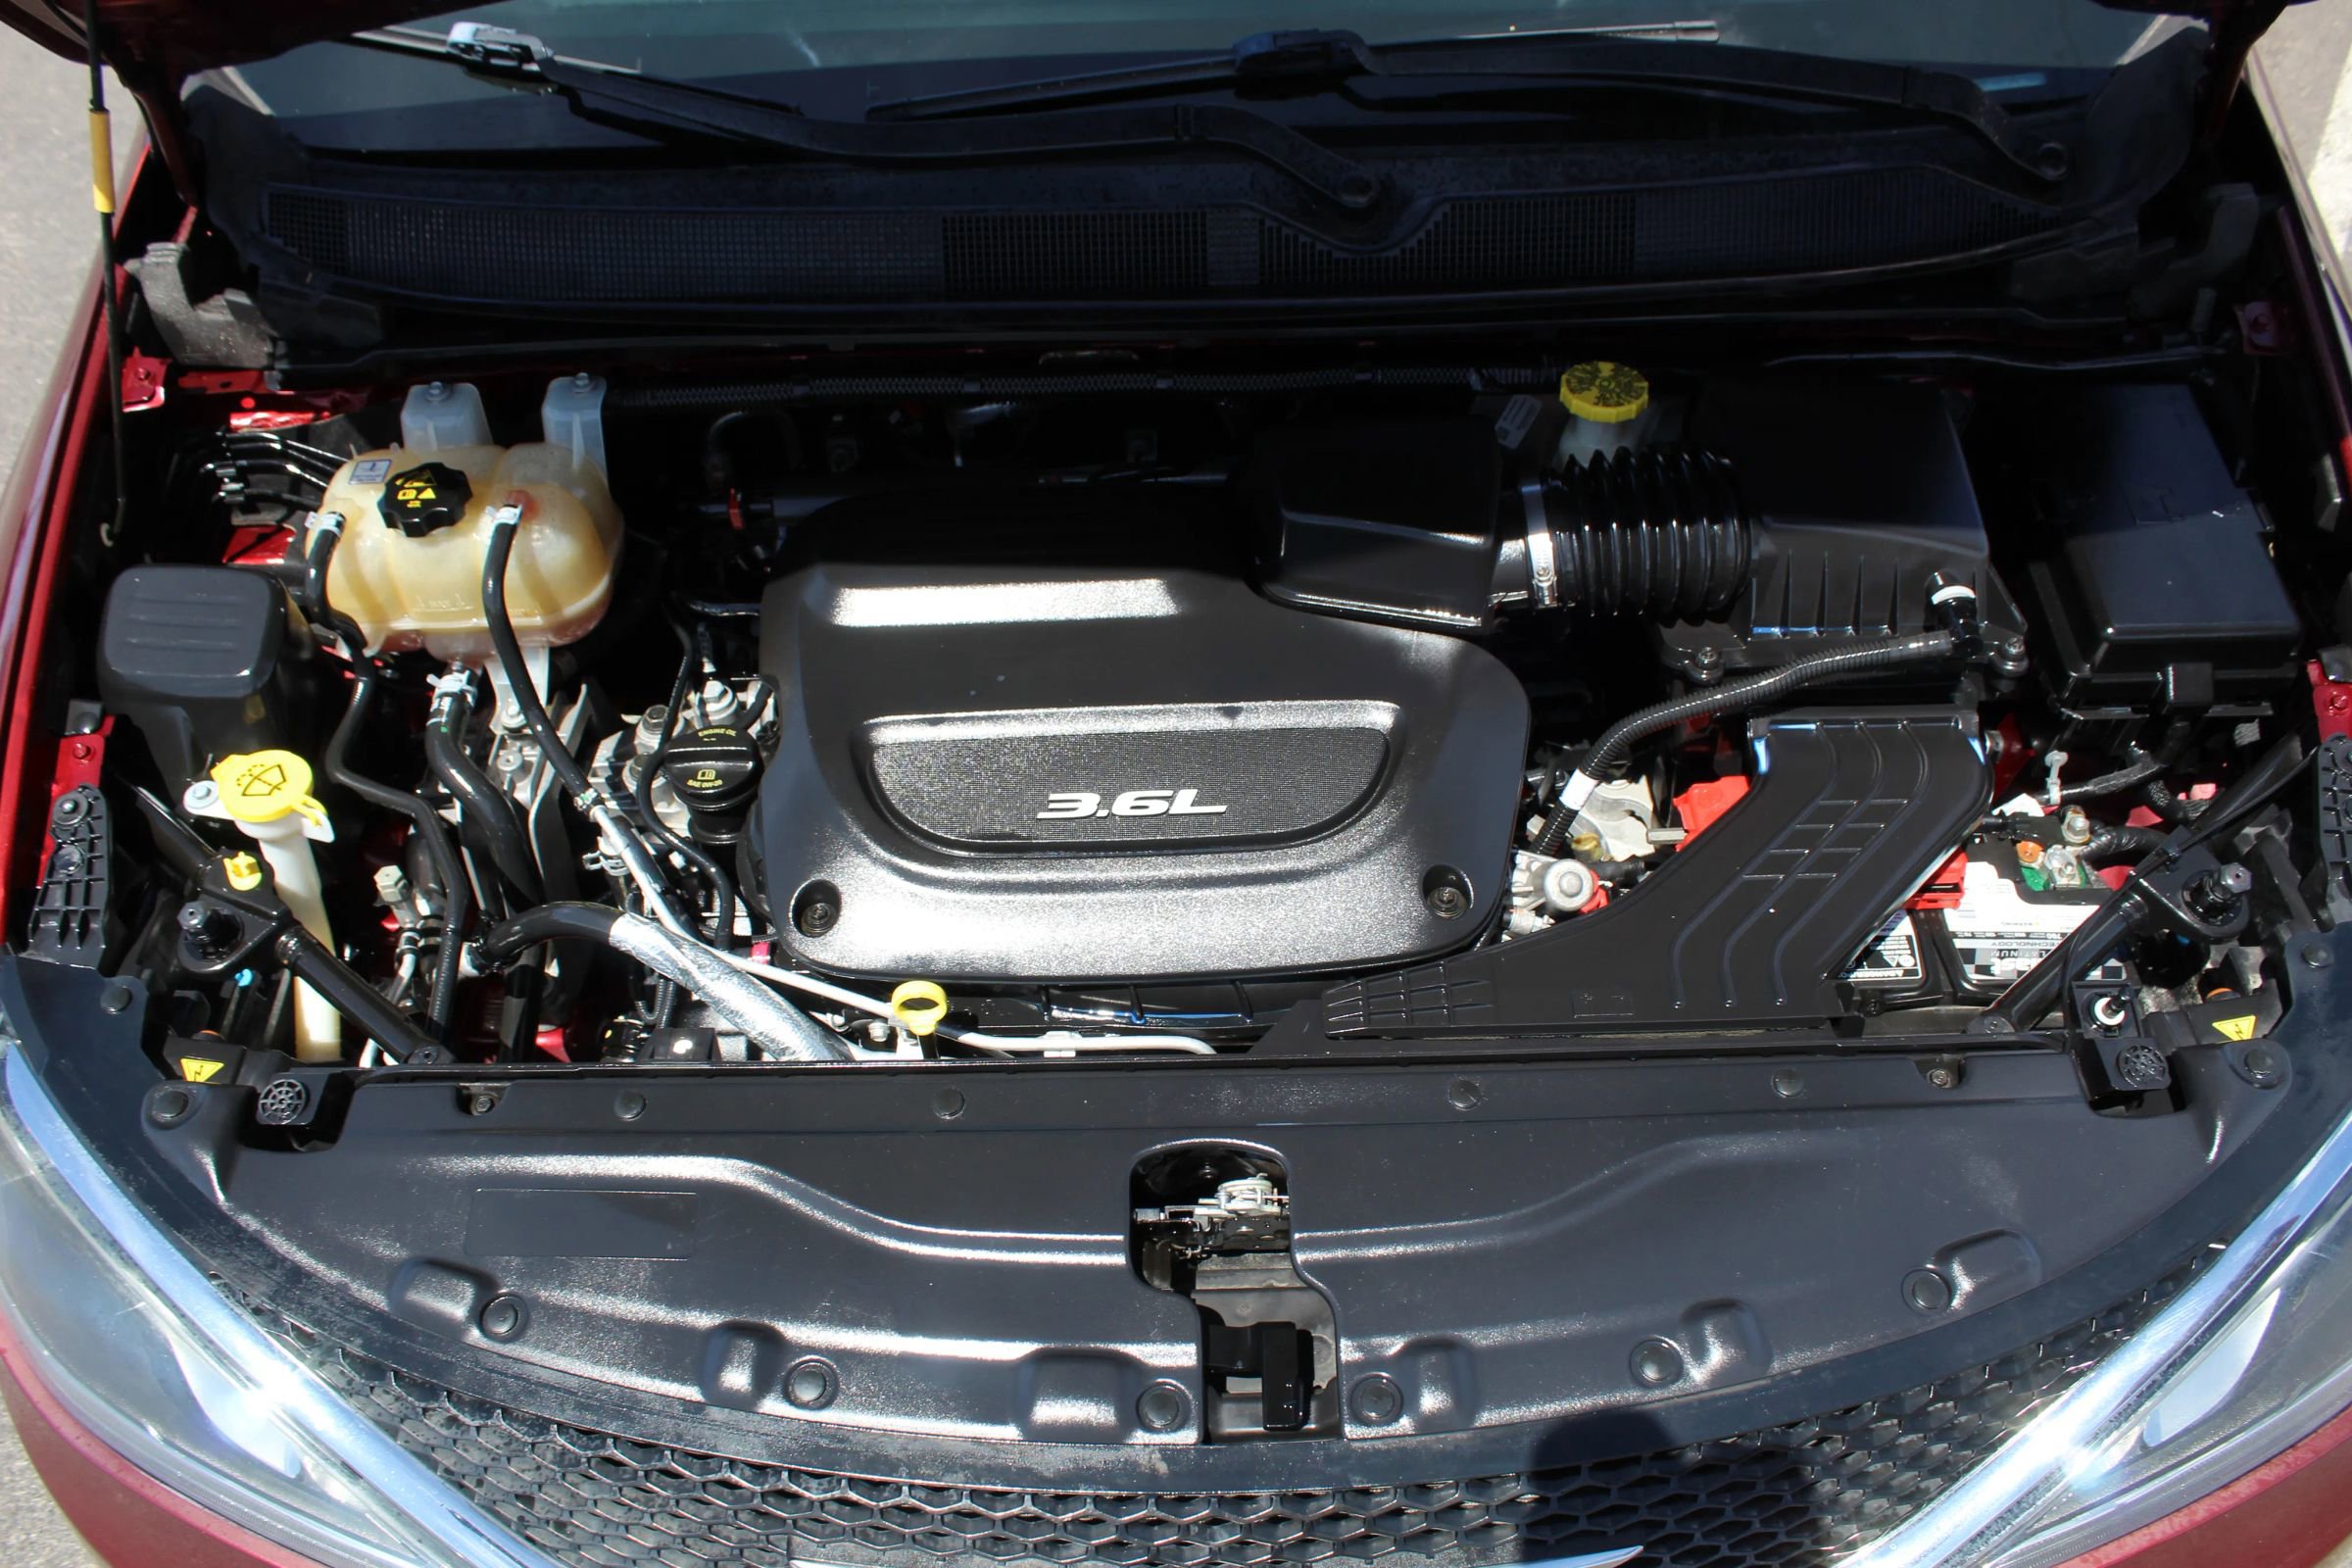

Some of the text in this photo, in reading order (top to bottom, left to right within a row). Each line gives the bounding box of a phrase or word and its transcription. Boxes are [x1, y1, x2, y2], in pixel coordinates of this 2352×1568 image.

[698, 728, 726, 737] ENGINE
[687, 779, 701, 788] SAE
[1037, 788, 1228, 819] 3.6L
